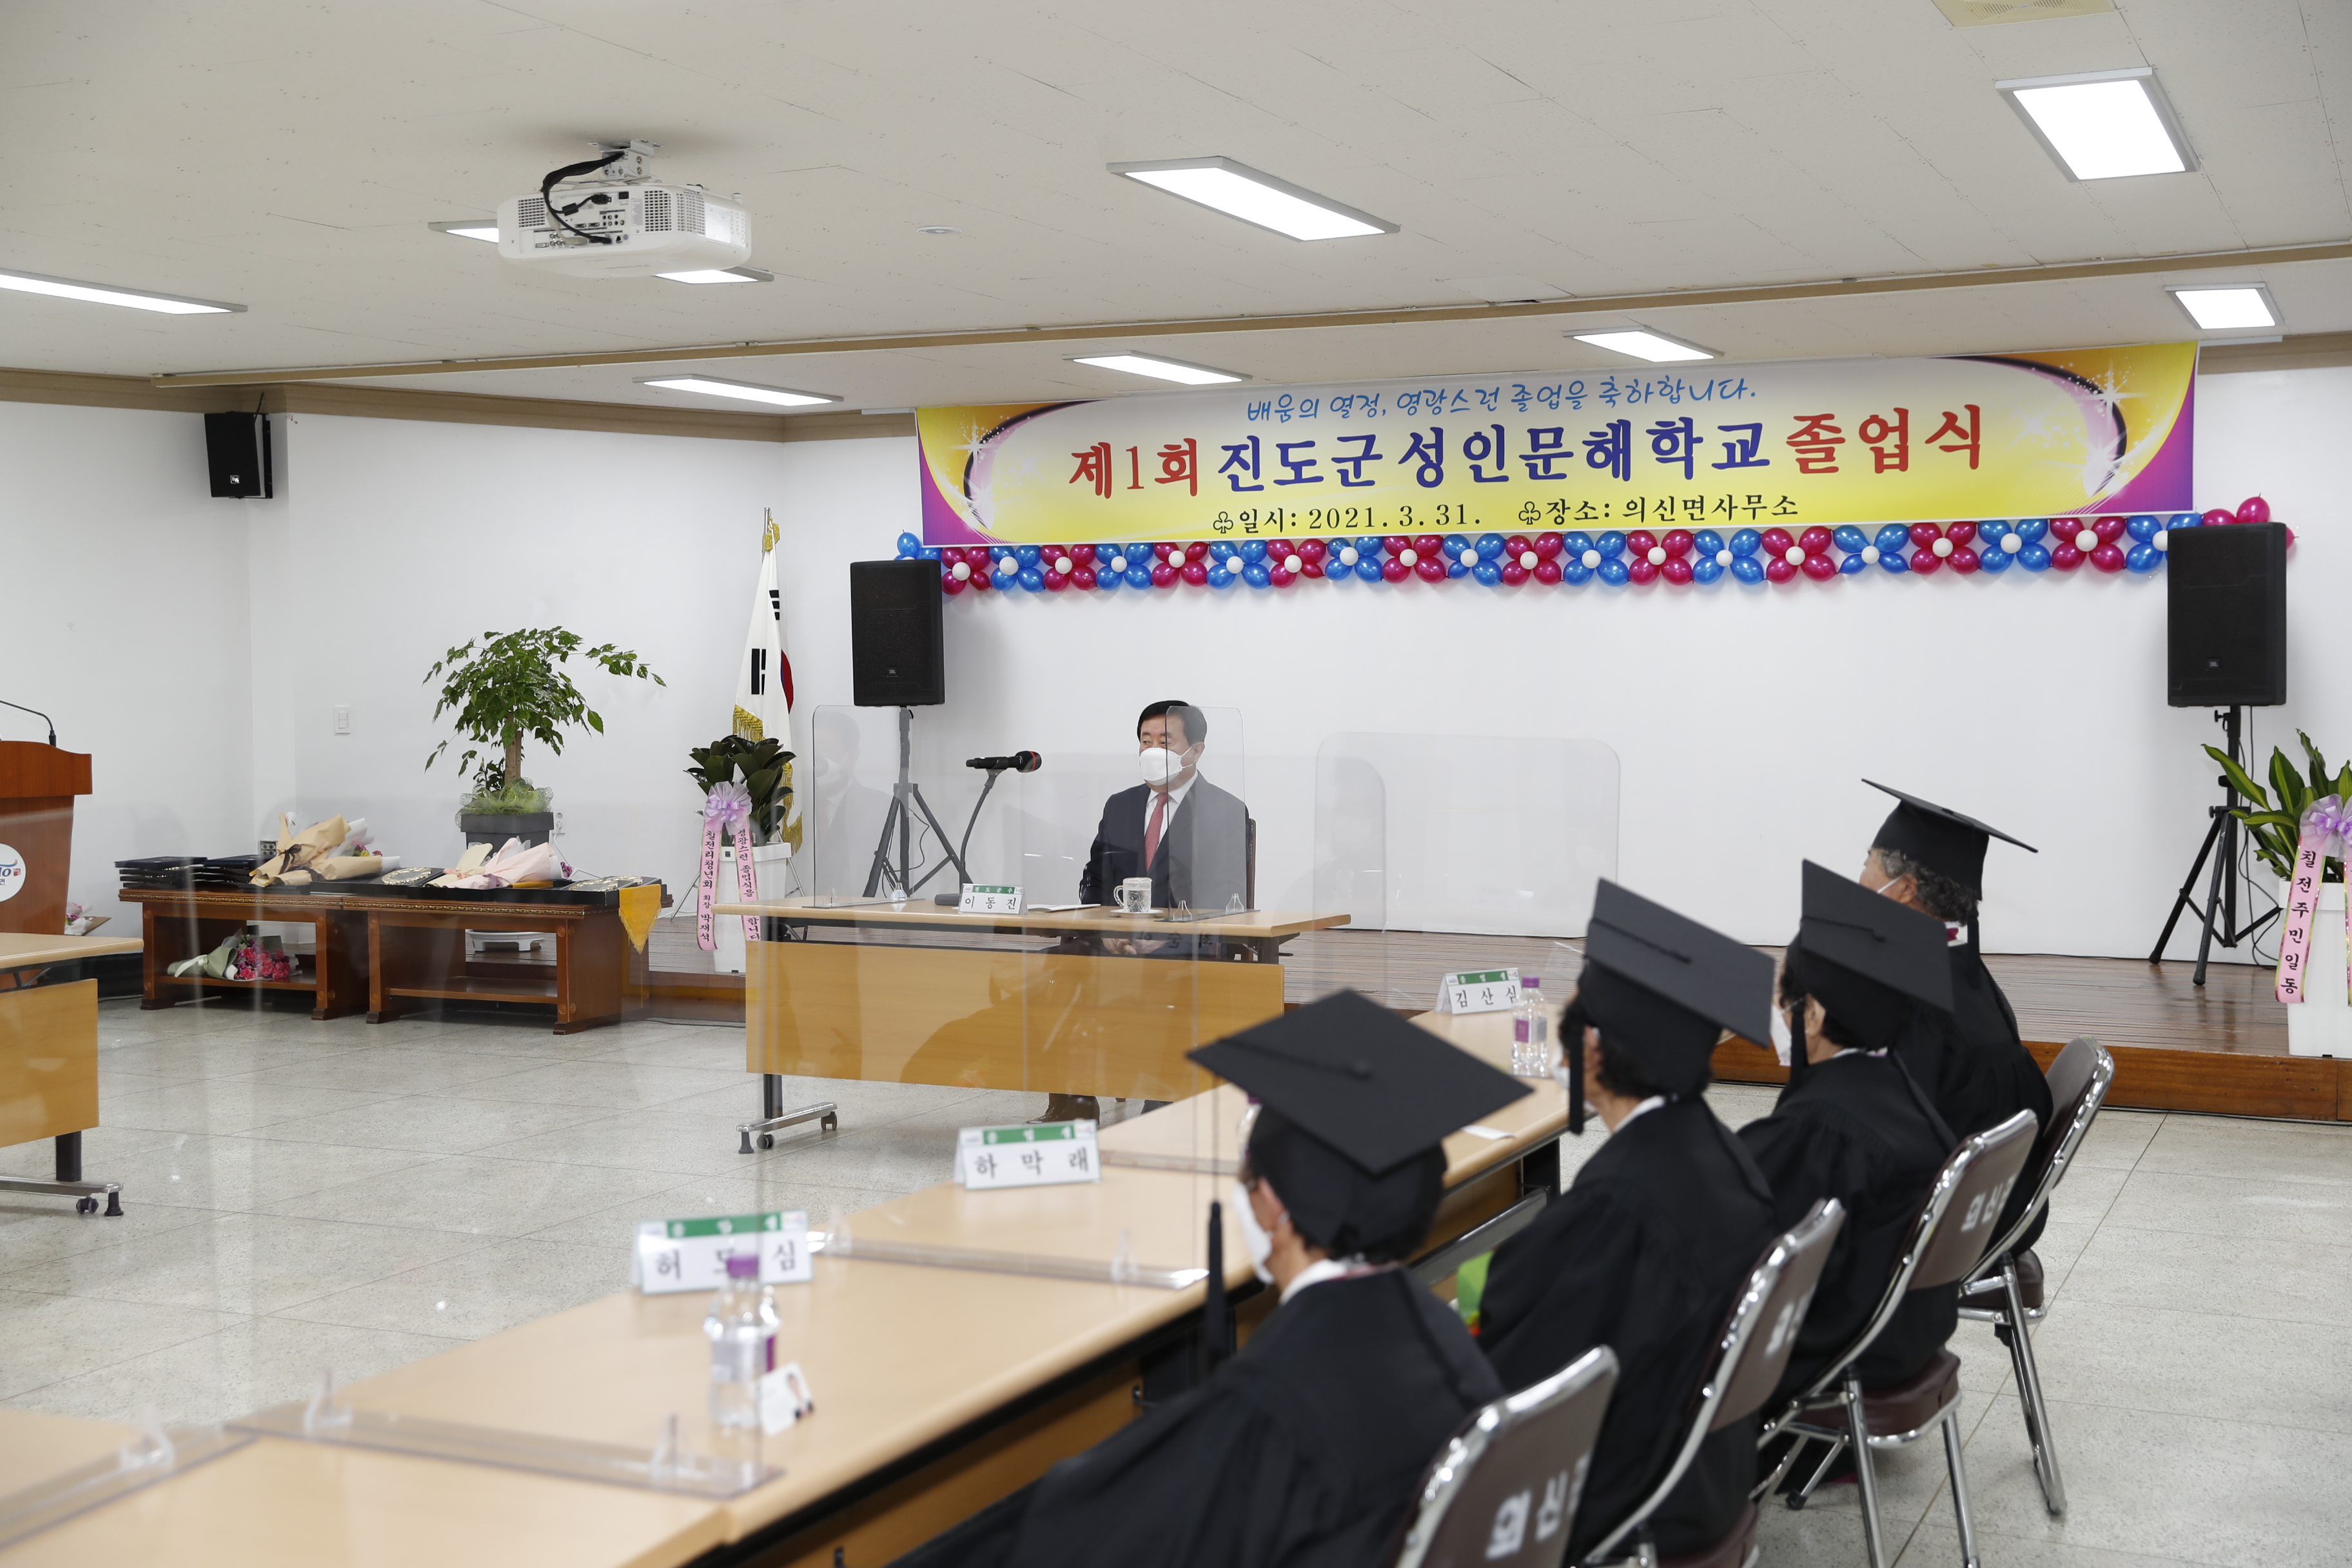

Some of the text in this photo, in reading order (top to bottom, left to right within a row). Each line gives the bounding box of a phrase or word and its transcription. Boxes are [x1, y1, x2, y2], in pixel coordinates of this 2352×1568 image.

[1247, 375, 1756, 424] 배움의 열정, 영광스런 졸업을 축하합니다.
[1068, 437, 1198, 499] 제1회
[1785, 404, 1981, 474] 졸업식
[1239, 507, 1297, 534] 일시:
[1545, 493, 1799, 525] 장소: 의신면사무소
[700, 913, 712, 942] 박재석
